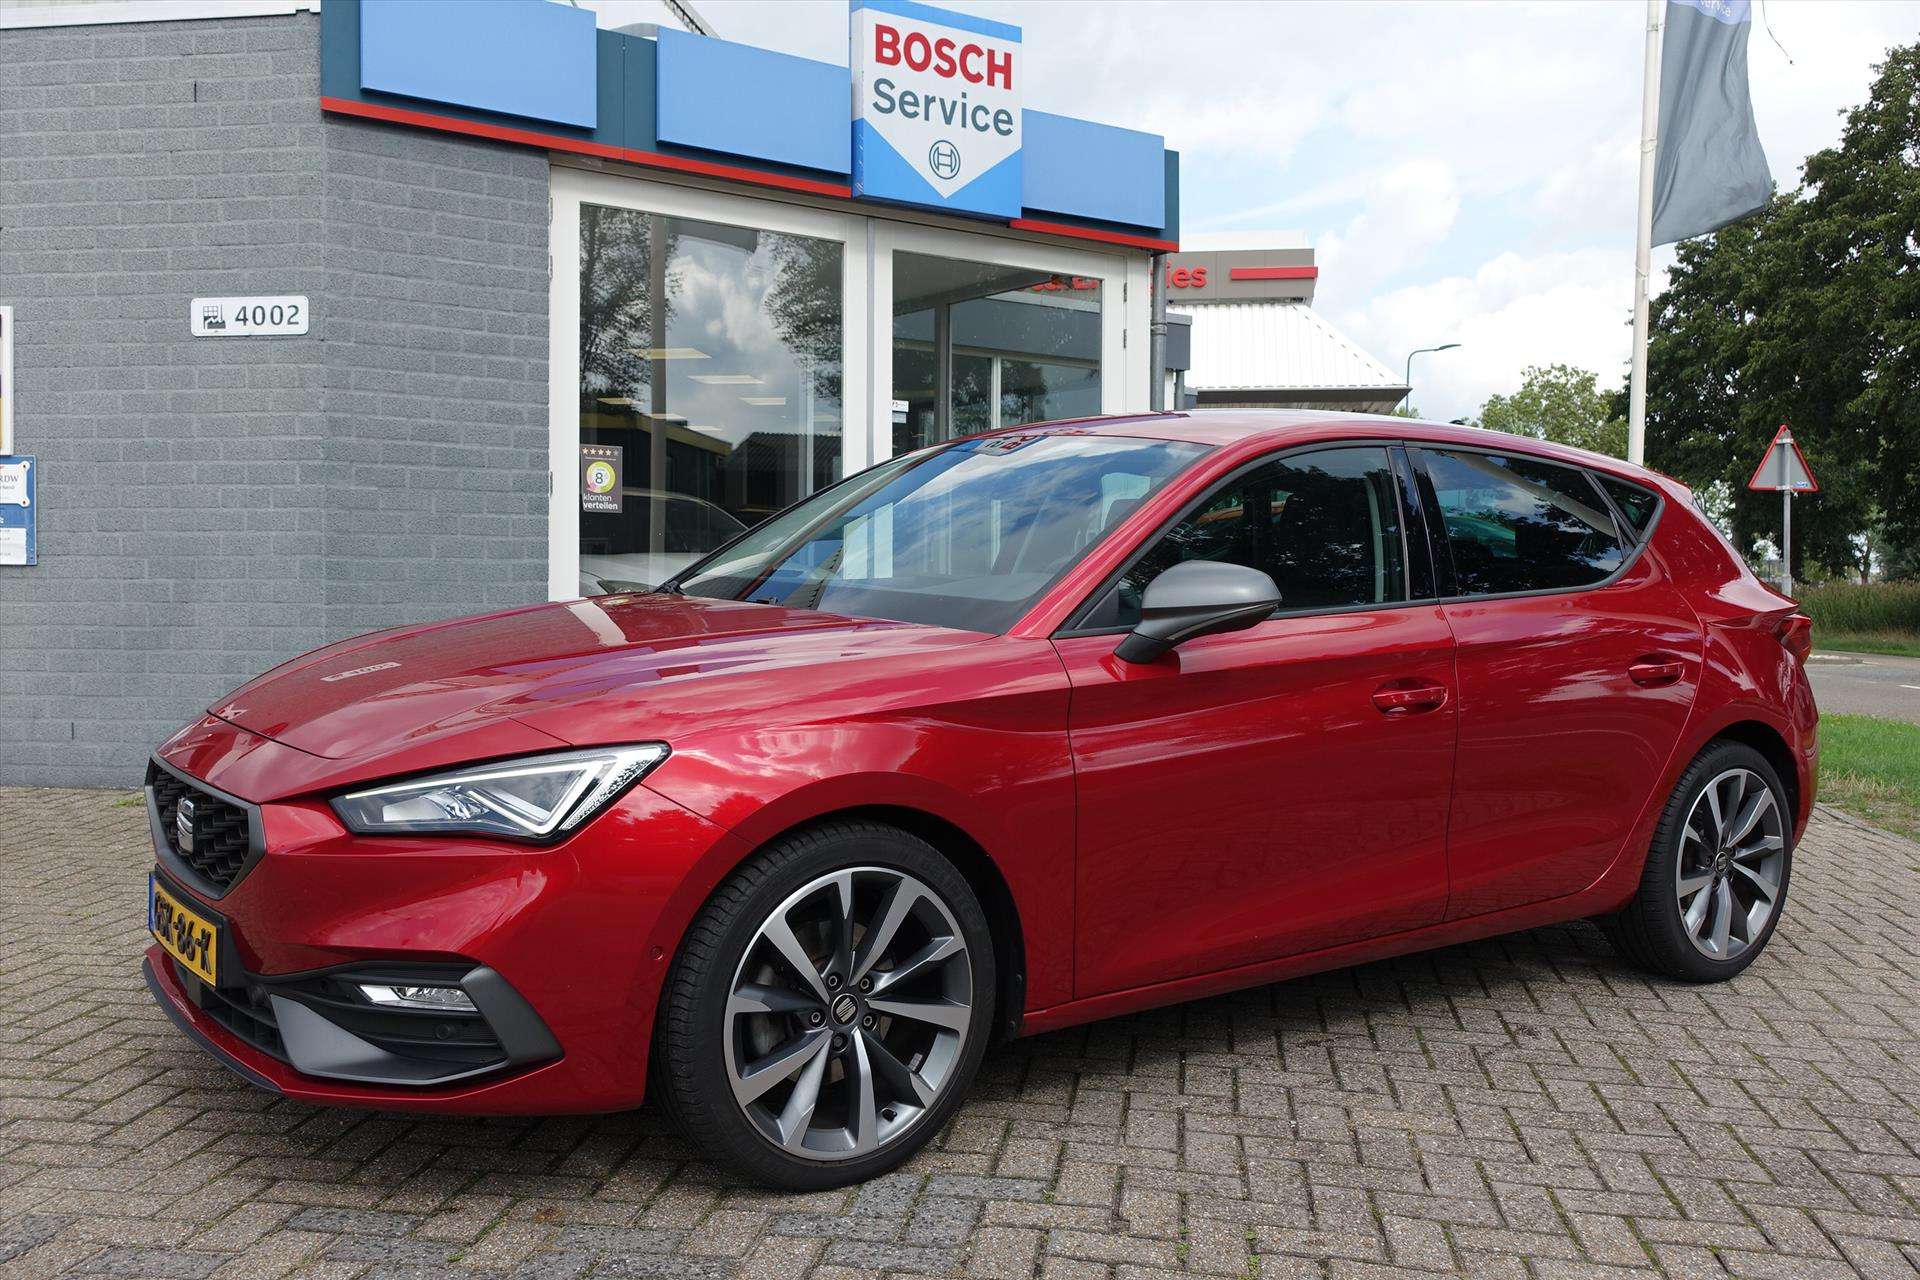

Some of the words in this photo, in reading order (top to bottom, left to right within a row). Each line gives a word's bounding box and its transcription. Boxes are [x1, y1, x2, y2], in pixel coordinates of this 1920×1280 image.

[875, 24, 1012, 90] BOSCH
[872, 78, 1014, 136] Service
[1150, 260, 1208, 289] ies
[235, 304, 300, 326] 4002
[582, 493, 612, 502] klanten
[583, 501, 618, 510] vertellen
